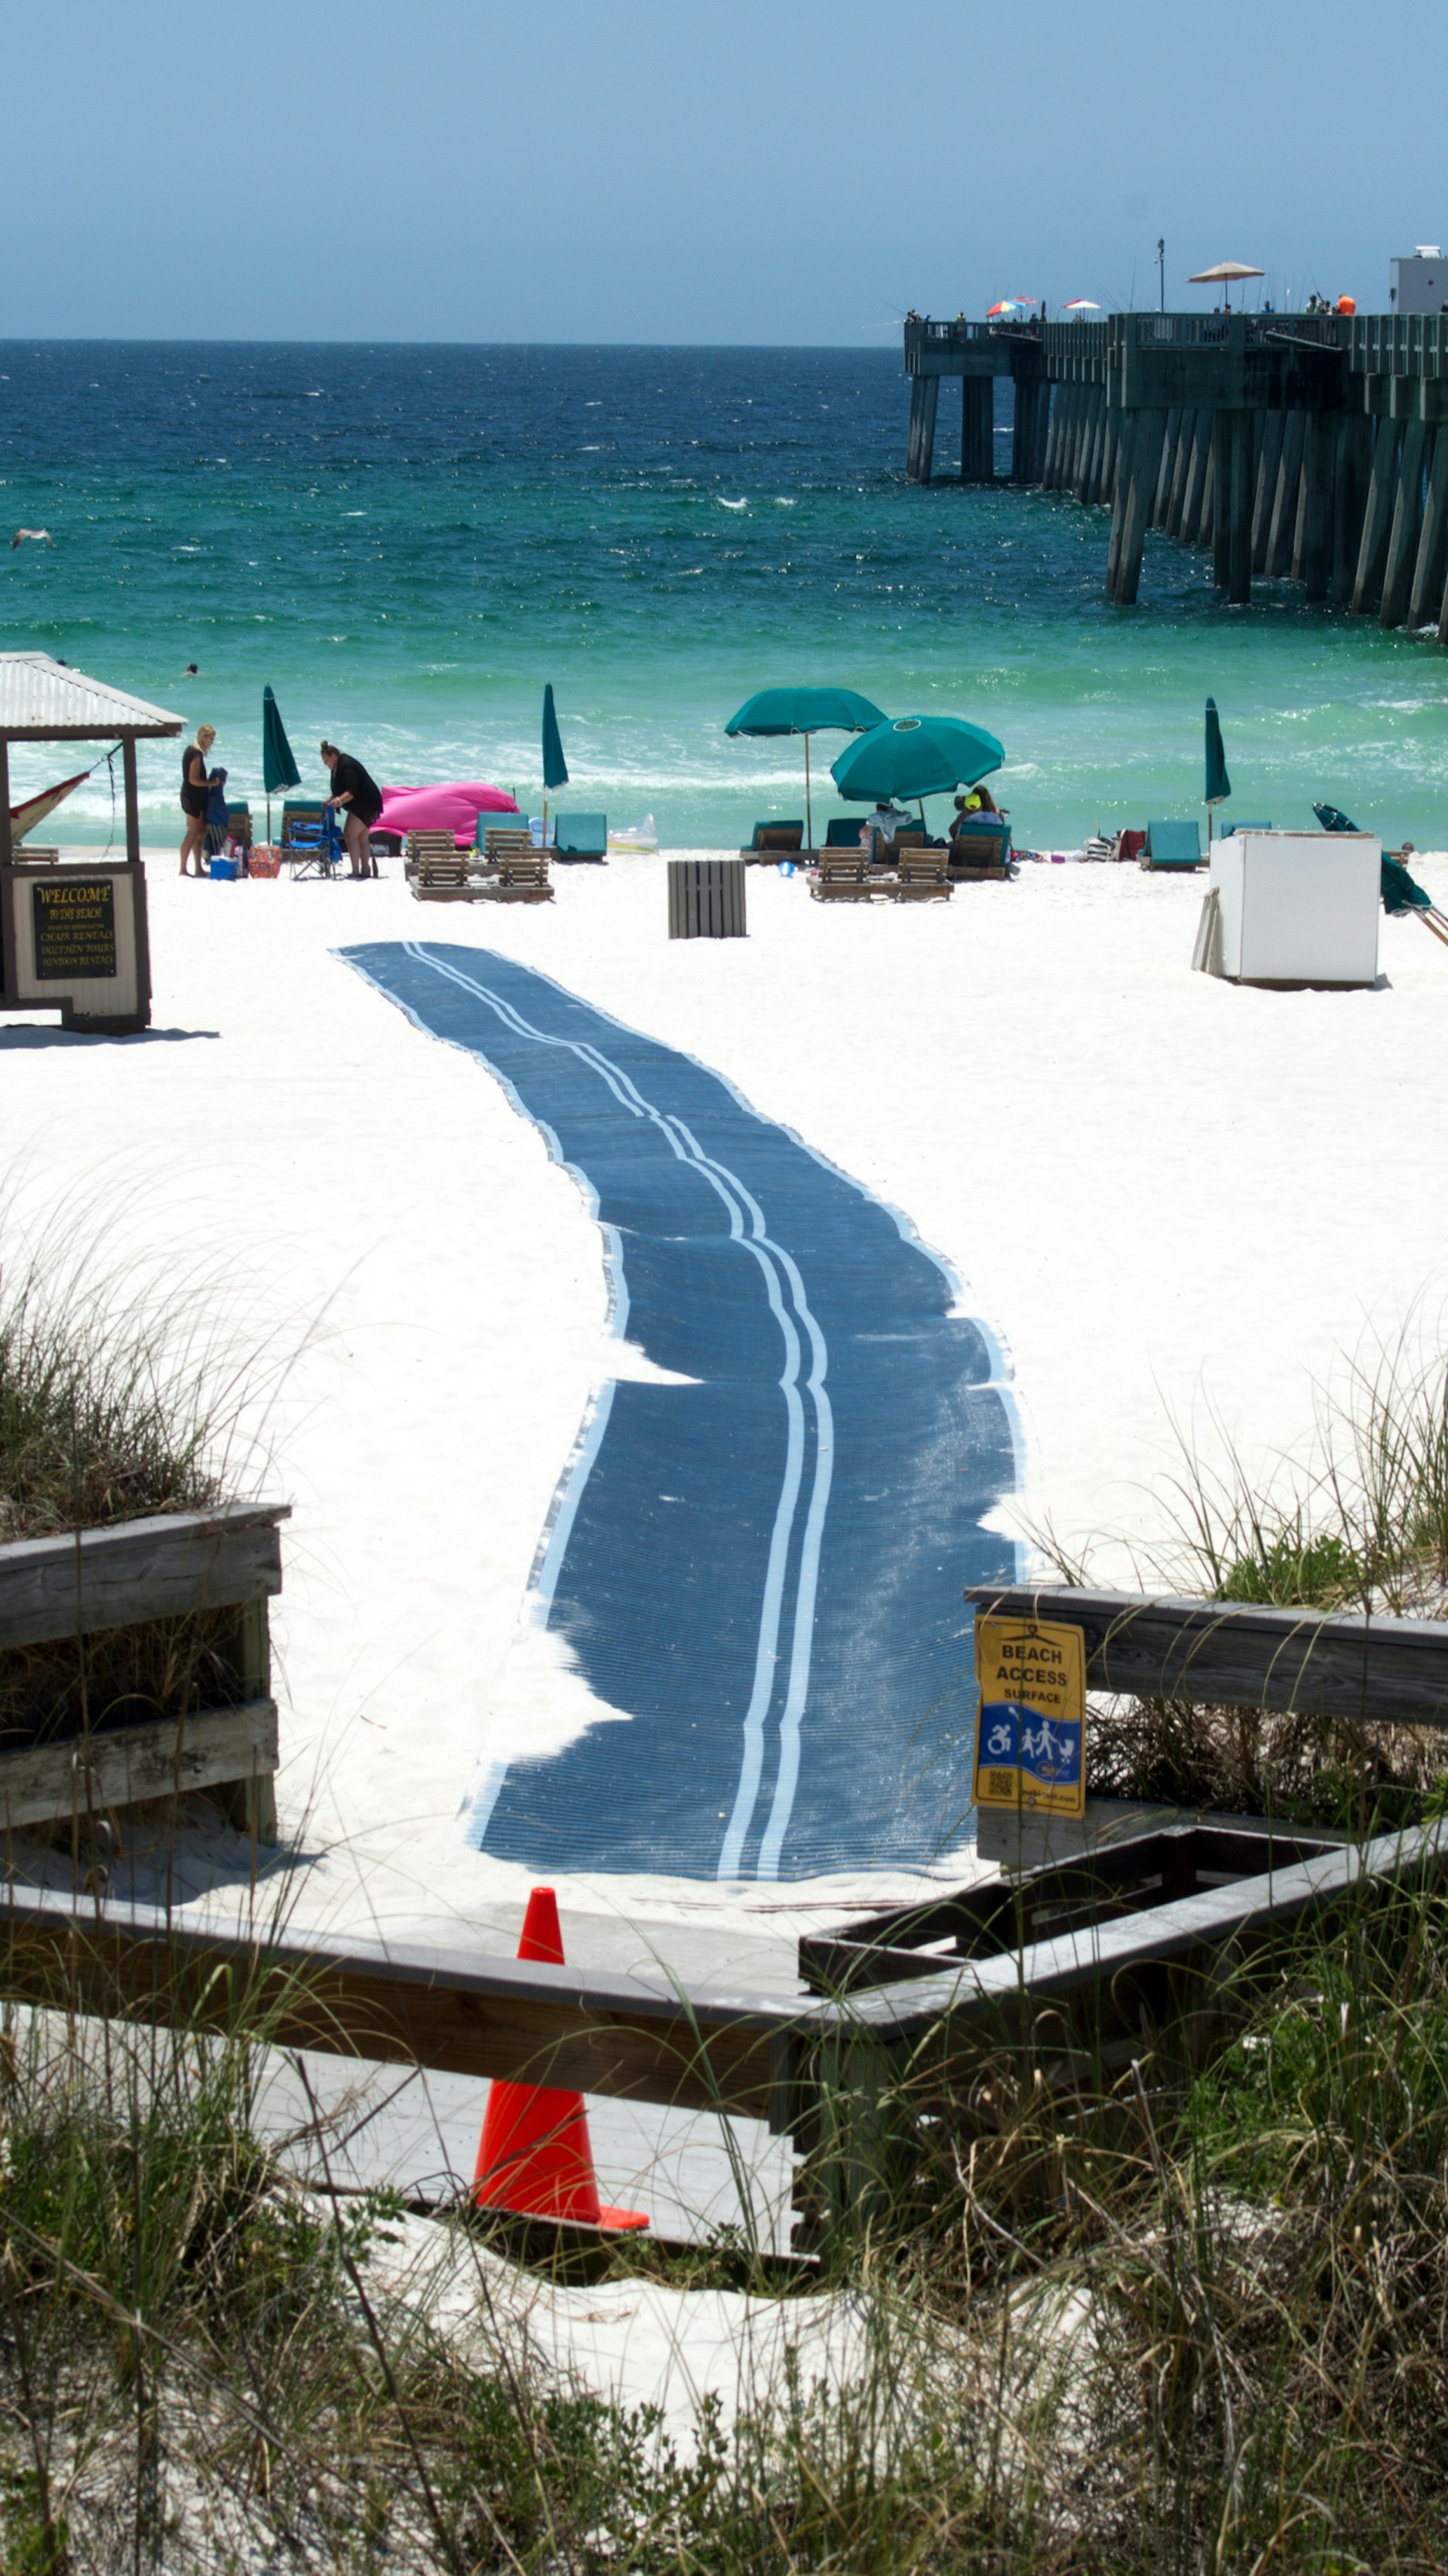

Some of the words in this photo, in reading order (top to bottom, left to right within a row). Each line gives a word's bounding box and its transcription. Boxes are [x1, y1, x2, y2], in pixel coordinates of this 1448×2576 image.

[38, 886, 109, 904] WELCOME
[60, 907, 75, 920] THE
[40, 932, 70, 942] CHAIR
[72, 930, 114, 941] RENTALS
[41, 944, 83, 955] DOLPHIN
[85, 943, 115, 953] TOURS
[42, 956, 78, 967] PONTOON
[79, 955, 113, 966] RENTALS
[1002, 1644, 1062, 1664] BEACH
[996, 1666, 1067, 1686] ACCESS
[1005, 1688, 1060, 1704] SURFACE
